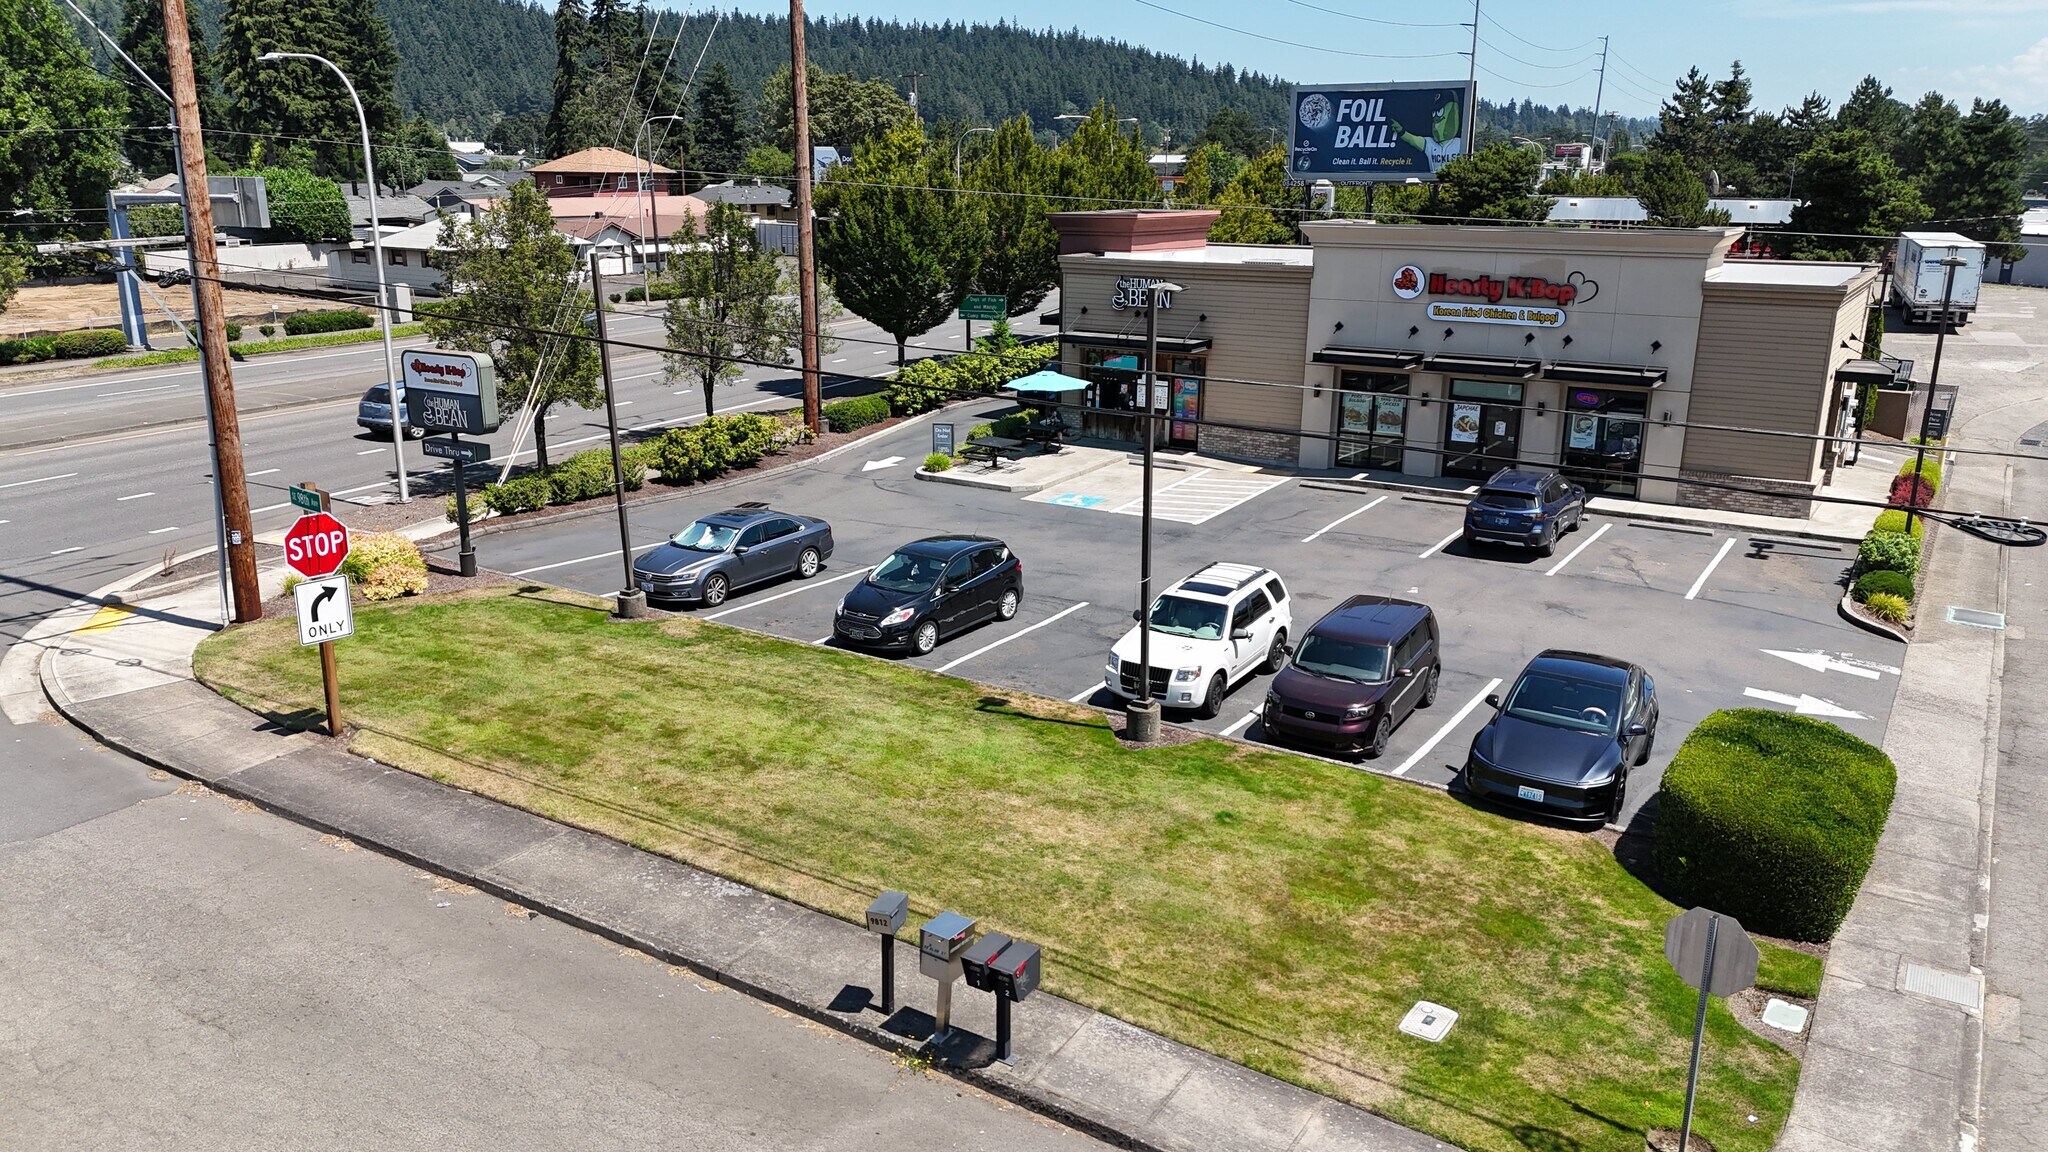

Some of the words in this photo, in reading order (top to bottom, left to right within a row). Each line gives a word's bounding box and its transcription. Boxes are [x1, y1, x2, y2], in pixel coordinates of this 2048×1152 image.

[1336, 98, 1386, 123] FOIL
[1334, 125, 1398, 149] BALL!
[1332, 157, 1350, 166] Clean
[1358, 157, 1371, 165] Ball
[1371, 157, 1379, 165] it.
[1380, 157, 1405, 166] Recycle
[1405, 157, 1413, 165] it.
[1119, 280, 1130, 289] the
[1428, 272, 1505, 303] Hearty
[1507, 276, 1578, 306] K-Bop
[1127, 288, 1171, 309] BEN
[1433, 306, 1461, 317] Korean
[1461, 307, 1483, 318] Fried
[1483, 308, 1517, 320] Chicken
[1518, 310, 1526, 321] &
[1527, 311, 1559, 323] Bulgogi
[433, 397, 460, 411] HUMAN
[434, 407, 469, 429] BEAN
[425, 443, 443, 454] Drive
[444, 446, 460, 457] Thru
[288, 530, 344, 561] STOP
[308, 620, 345, 638] ONLY
[870, 917, 888, 927] 9812
